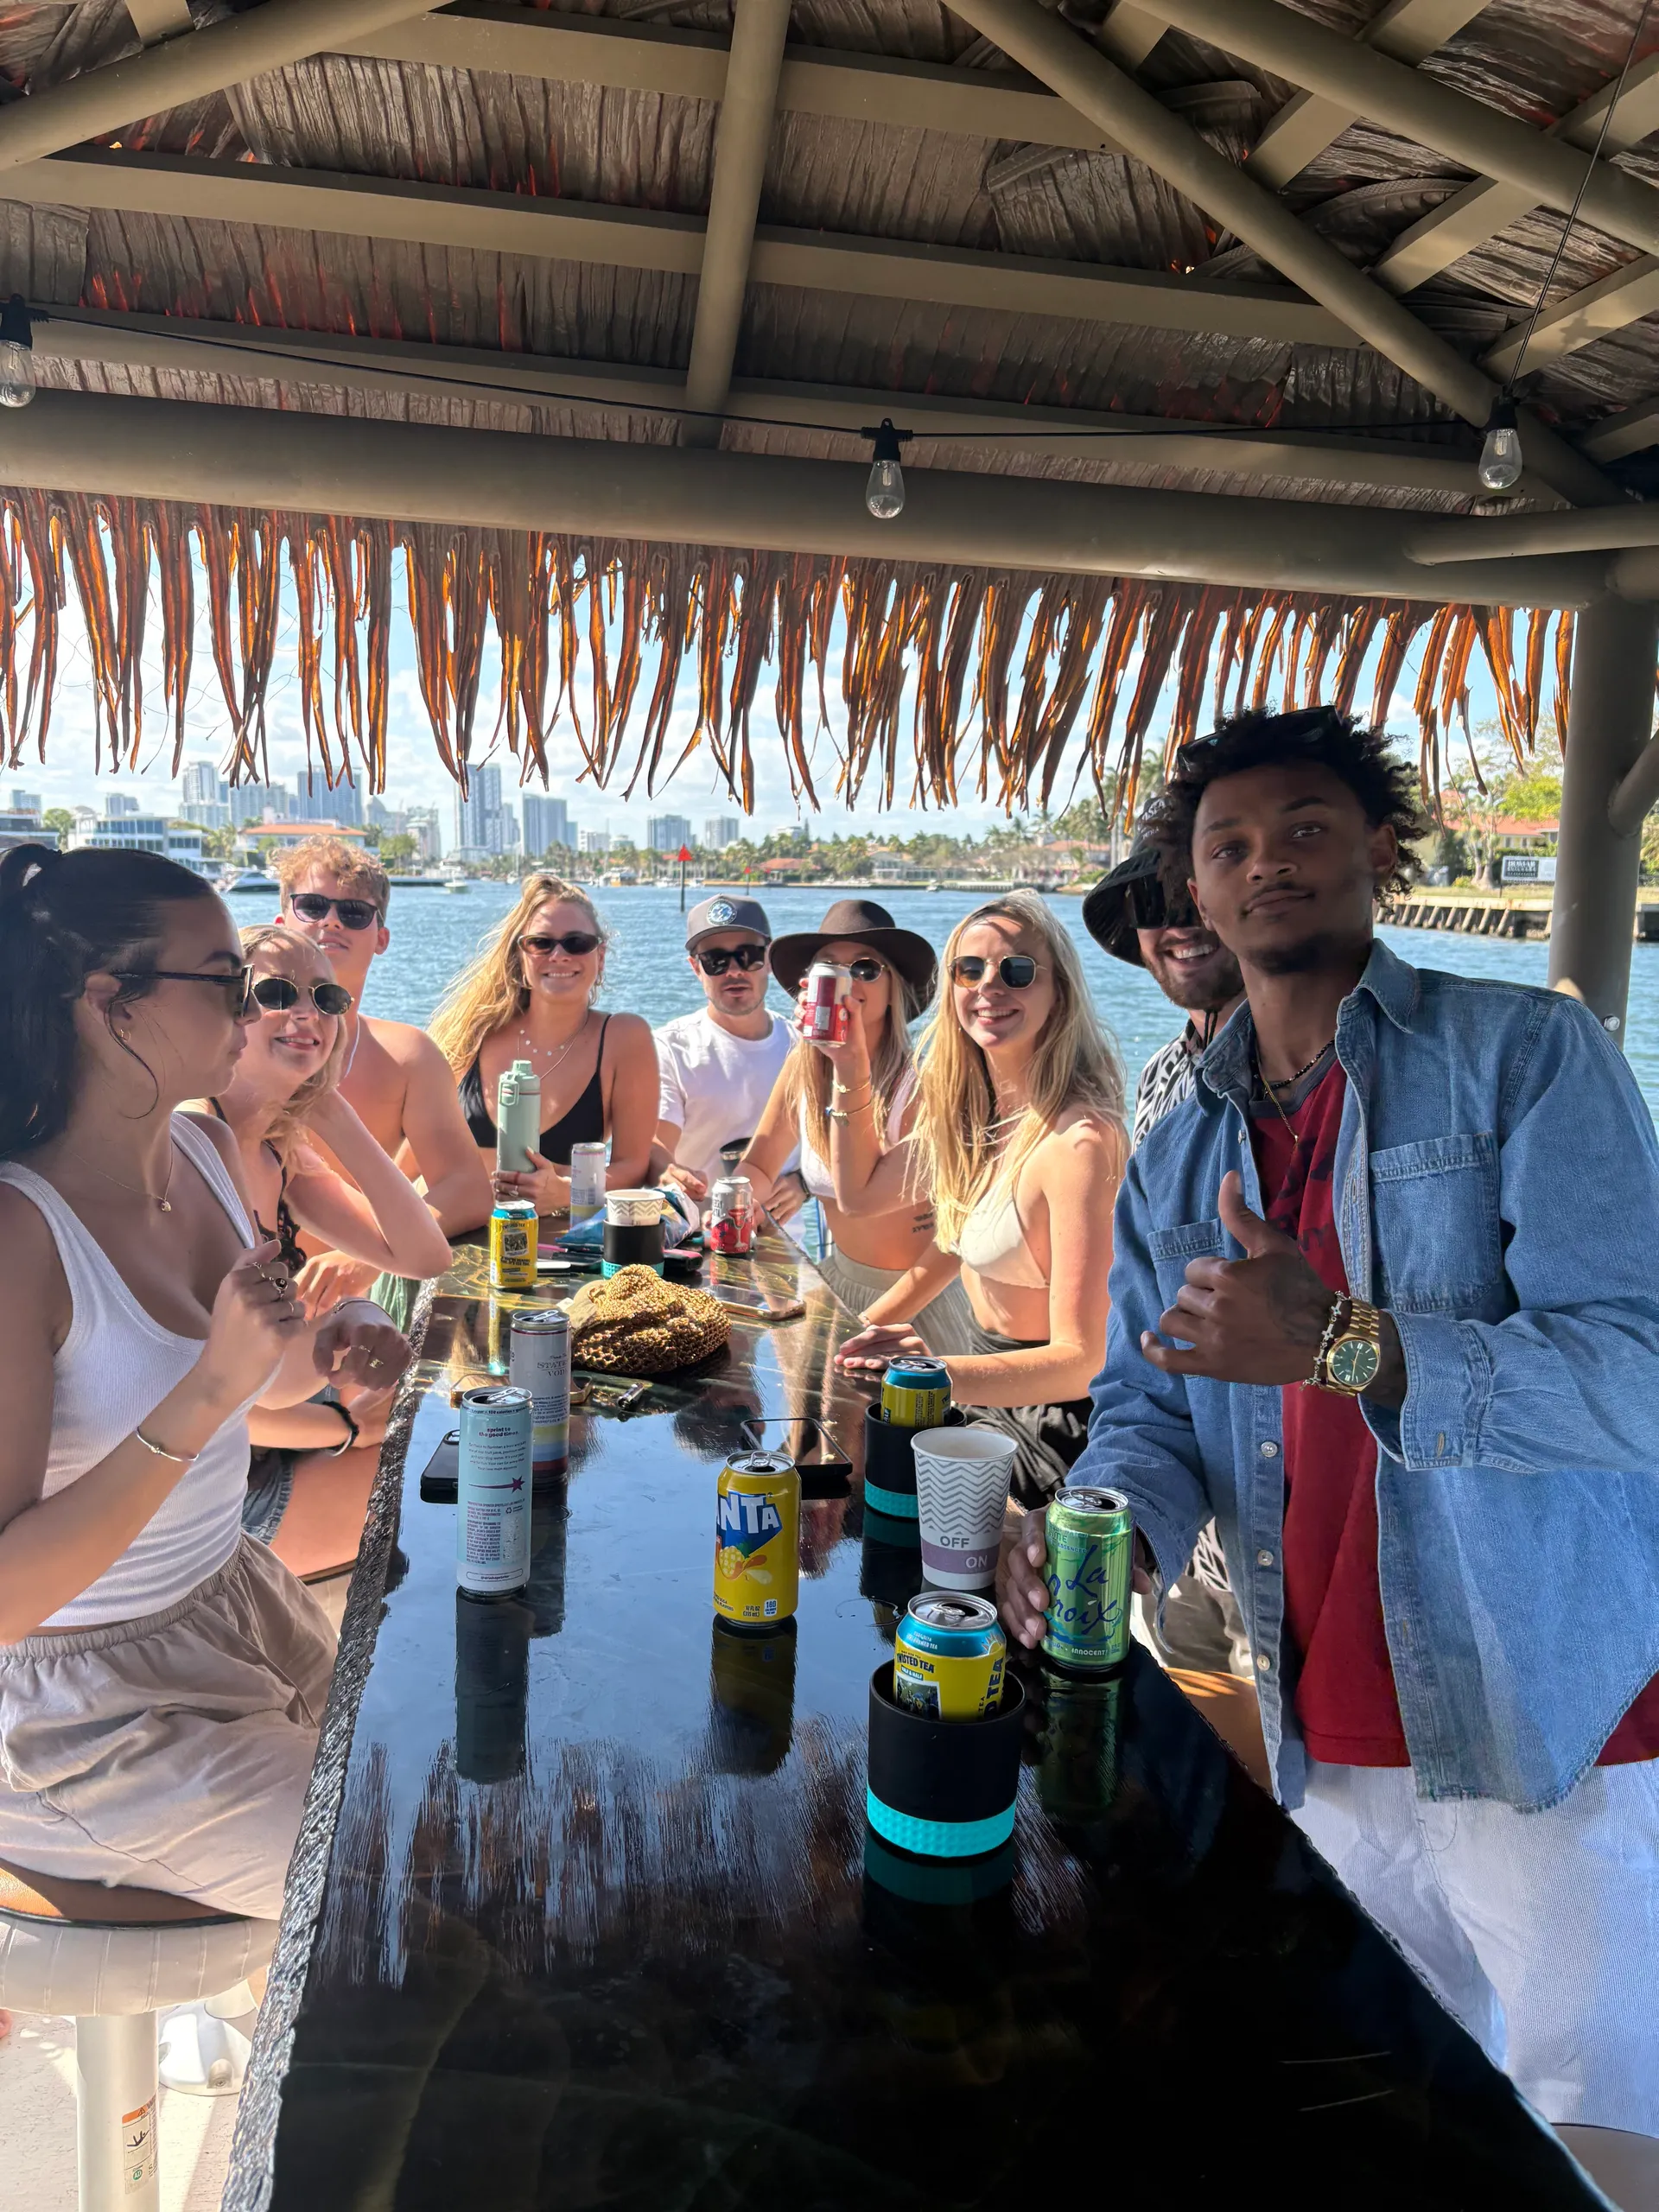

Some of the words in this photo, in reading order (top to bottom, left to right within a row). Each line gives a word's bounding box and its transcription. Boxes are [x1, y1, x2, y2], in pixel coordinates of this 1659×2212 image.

[717, 1494, 779, 1534] NTA
[939, 1535, 969, 1548] OFF
[965, 1554, 988, 1568] ON
[1065, 1544, 1109, 1599] La
[919, 1659, 935, 1673] TEA
[986, 1657, 1003, 1700] TEA
